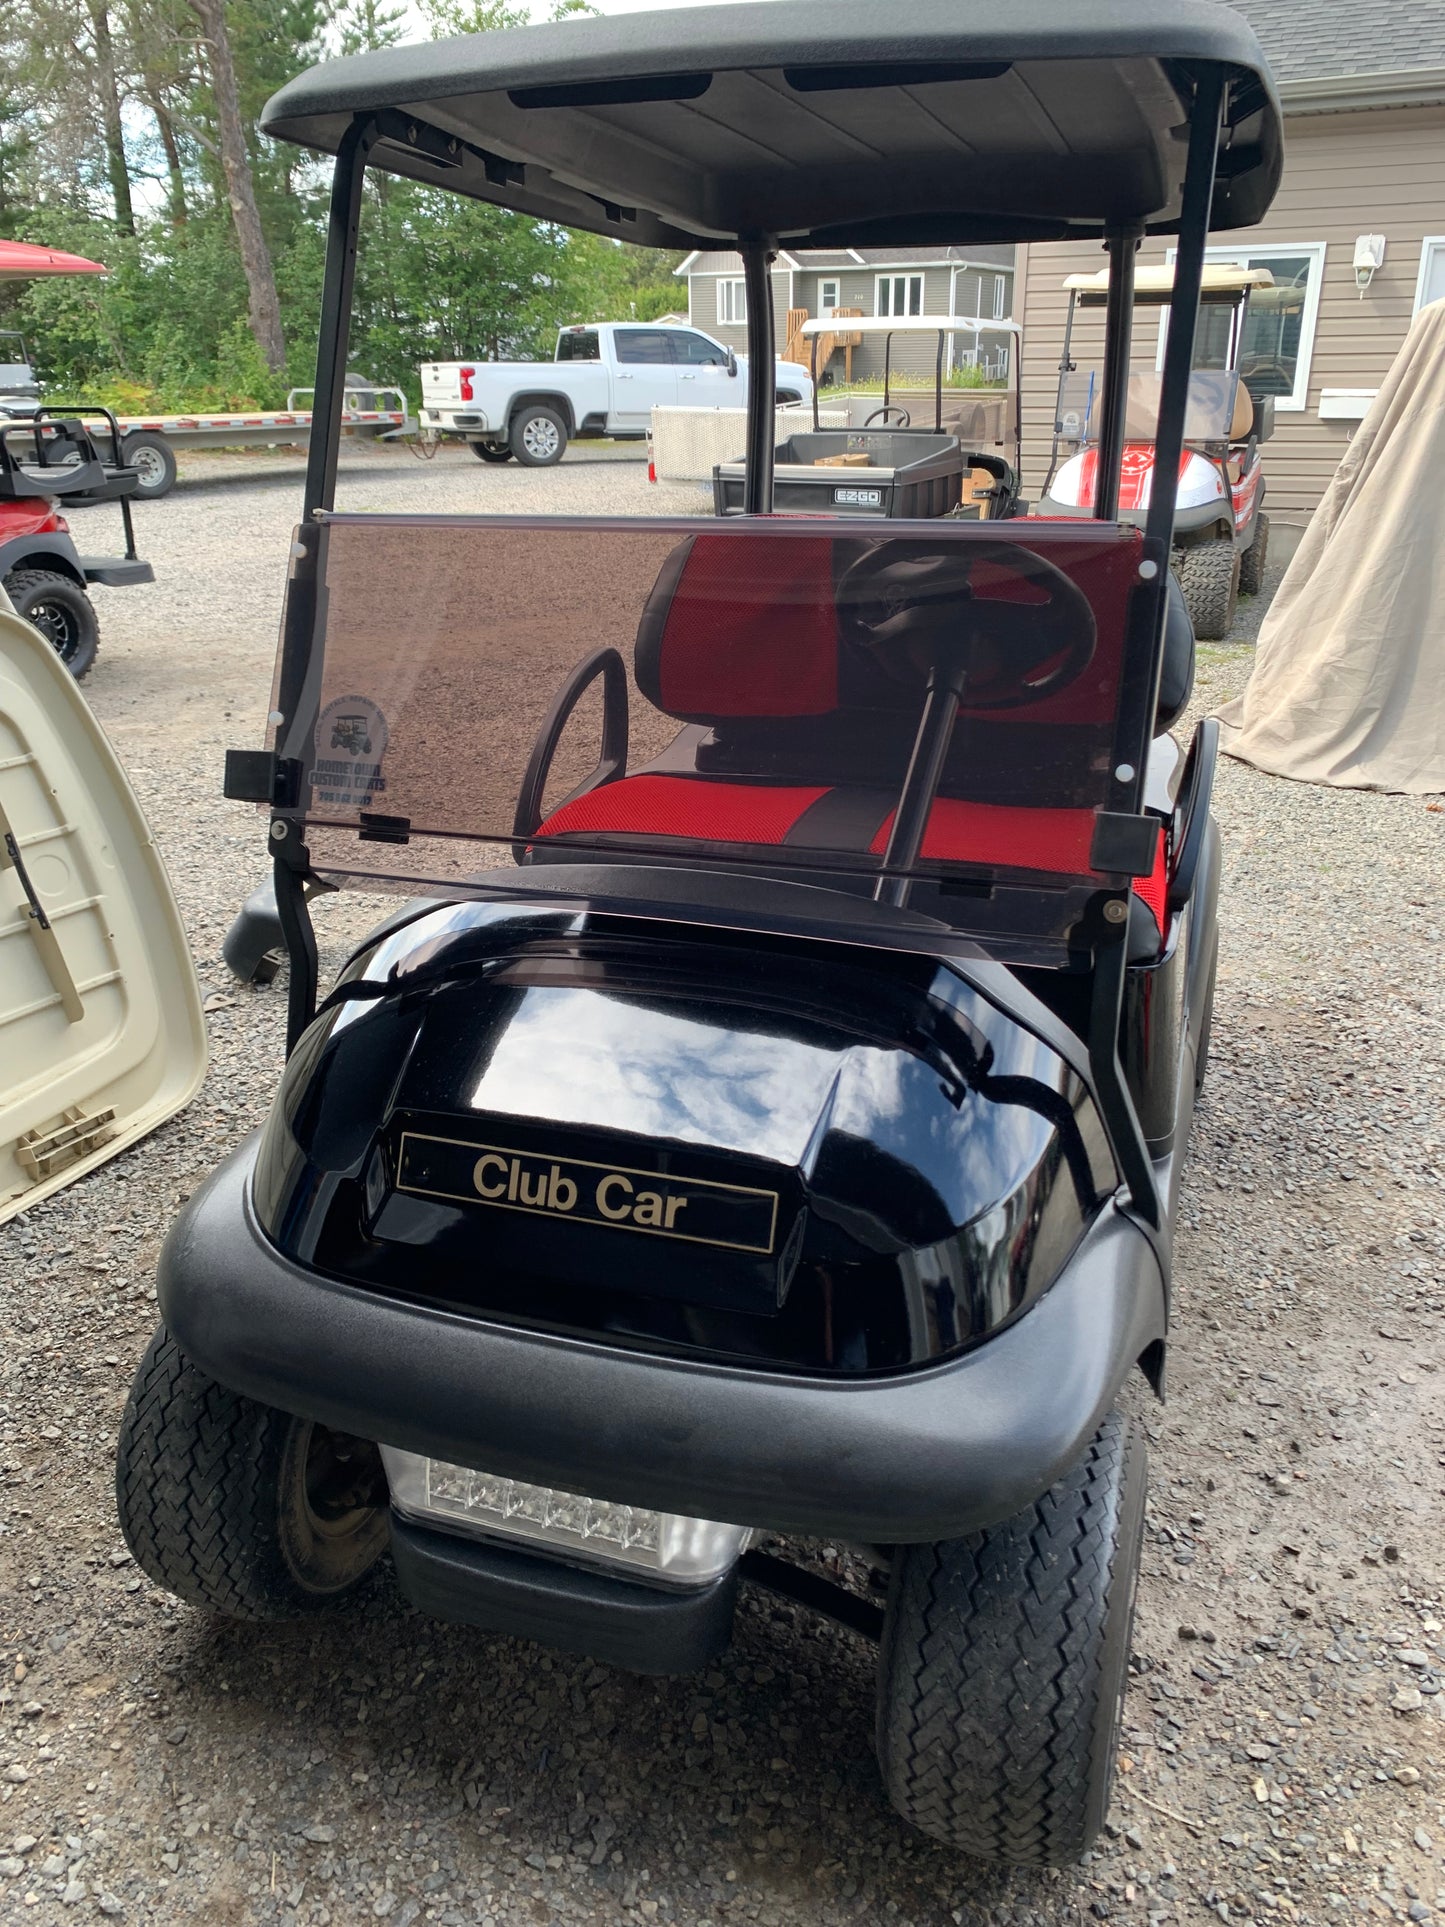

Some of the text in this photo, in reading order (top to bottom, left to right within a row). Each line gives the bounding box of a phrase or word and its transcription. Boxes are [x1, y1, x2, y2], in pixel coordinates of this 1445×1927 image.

[310, 772, 351, 788] CUSTOM
[473, 1153, 687, 1229] Club Car
